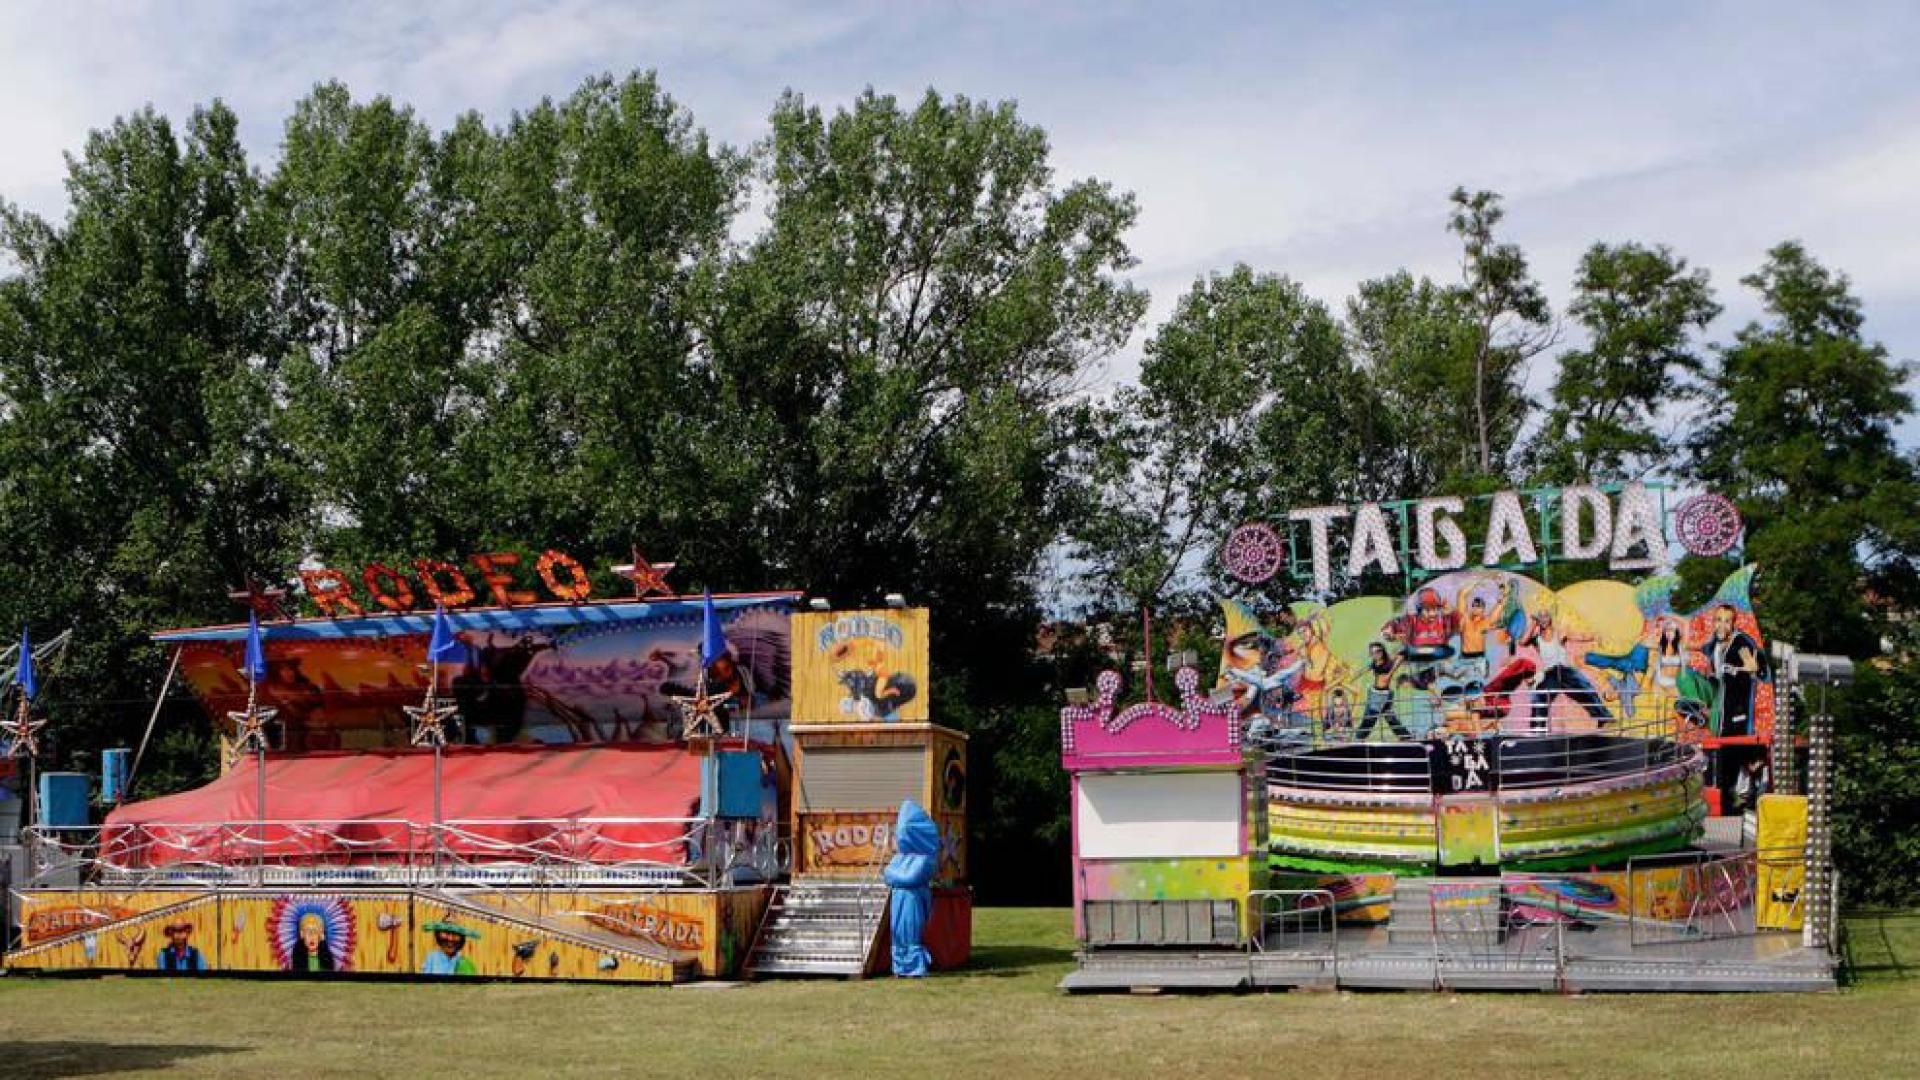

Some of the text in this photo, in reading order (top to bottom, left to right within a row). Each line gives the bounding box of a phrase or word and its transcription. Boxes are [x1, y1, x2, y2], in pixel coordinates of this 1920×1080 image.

[1288, 482, 1669, 594] TAGADA
[299, 549, 592, 617] RODEO
[813, 823, 898, 855] RODE
